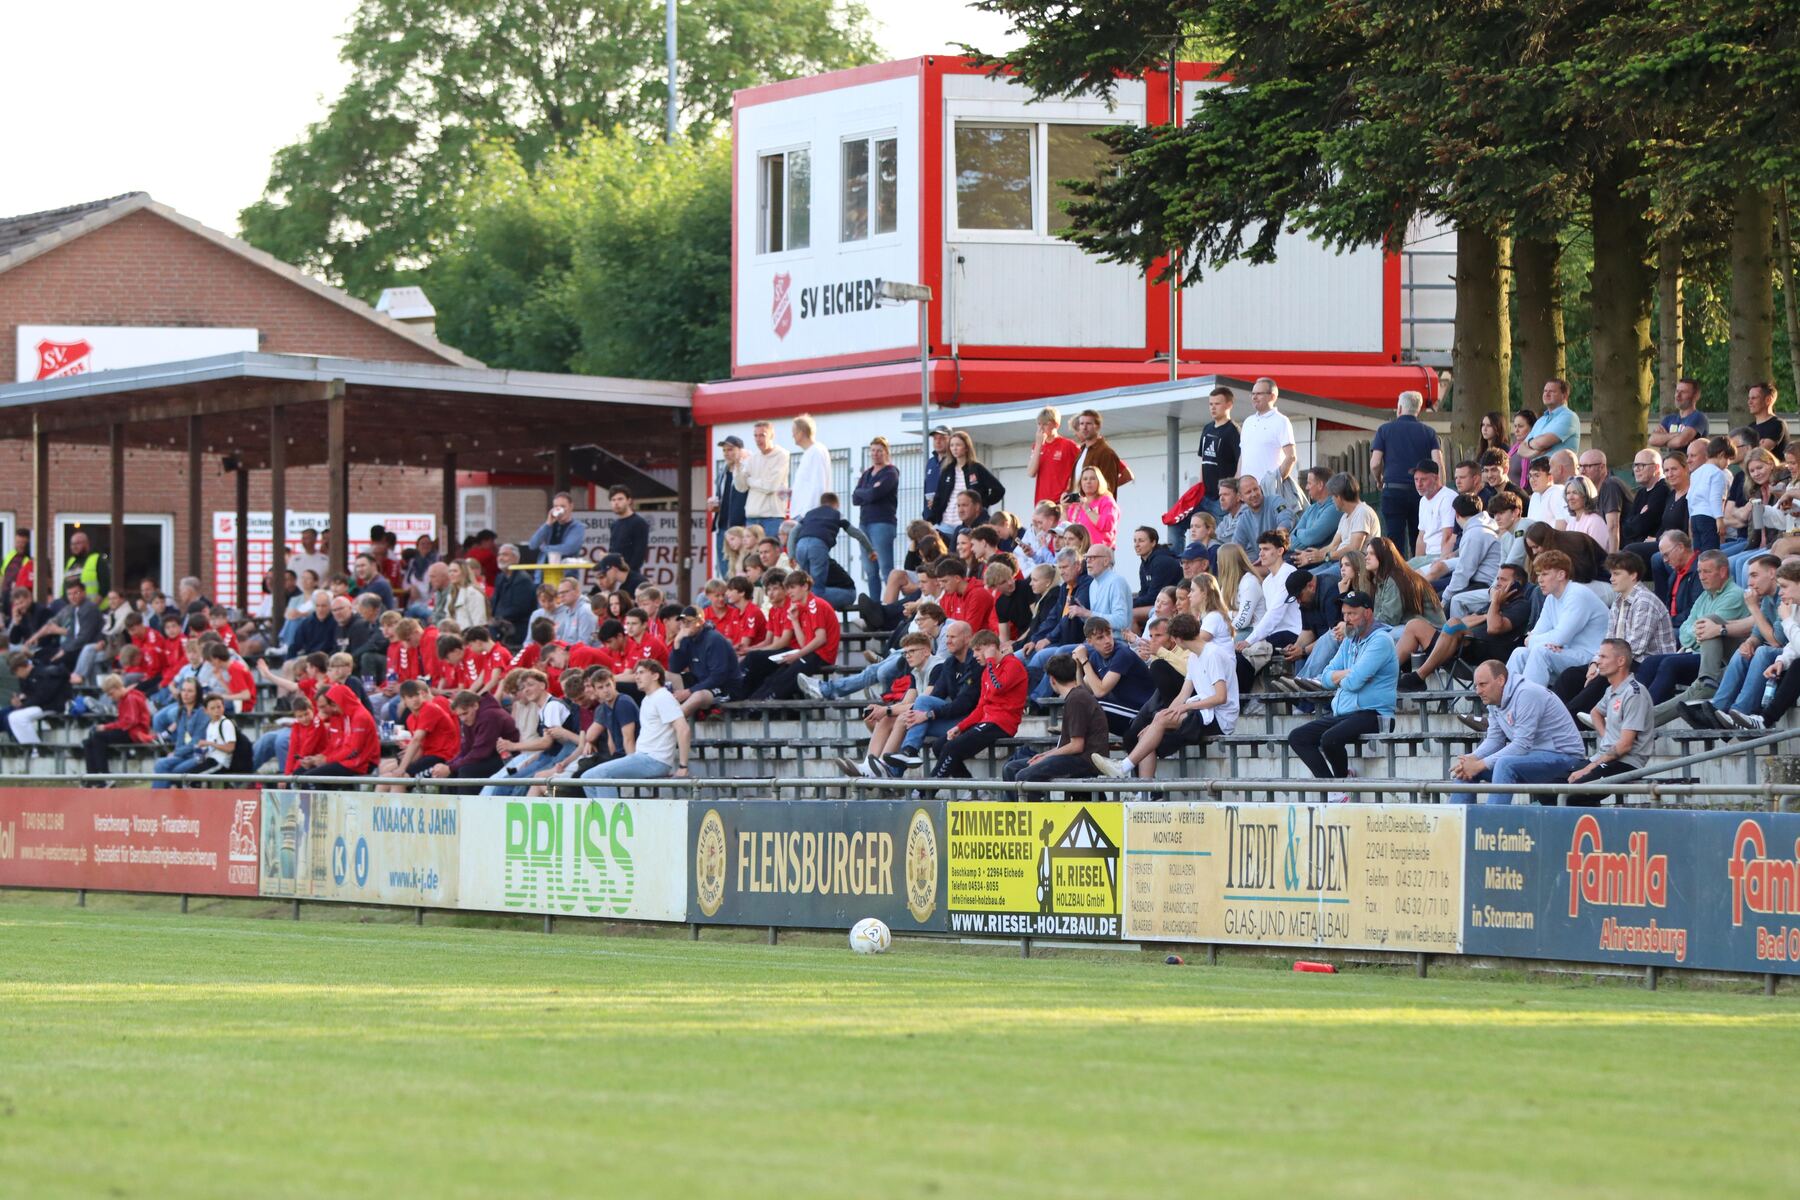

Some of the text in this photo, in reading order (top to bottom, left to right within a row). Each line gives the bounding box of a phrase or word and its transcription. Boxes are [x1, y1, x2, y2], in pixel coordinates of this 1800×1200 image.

[800, 287, 818, 319] SV
[372, 806, 456, 836] KNAACK & JAHN
[951, 810, 1032, 836] ZIMMEREI
[1132, 812, 1205, 825] HERSTELLUNG VERTRIEB
[1433, 816, 1439, 833] 7
[0, 821, 15, 859] oll
[1153, 831, 1183, 844] MONTAGE
[1284, 805, 1301, 891] &
[1475, 827, 1536, 852] Ihre famila-
[335, 846, 366, 878] K J
[737, 831, 893, 895] FLENSBURGER
[951, 841, 1033, 860] DACHDECKEREI
[1366, 842, 1388, 859] 22941
[1004, 867, 1024, 878] Eichede
[1056, 865, 1105, 887] H. RIESEL
[1365, 868, 1389, 887] Telefon
[1484, 866, 1523, 891] Märkte
[1566, 814, 1668, 918] famila
[1728, 819, 1800, 926] fami
[389, 867, 438, 893] www.k-j.de
[952, 880, 967, 891] Telefon
[1056, 893, 1105, 908] HOLZBAU GmbH
[1163, 901, 1199, 914] BRANDSCHUTZ
[1366, 895, 1377, 913] Fax
[951, 913, 1117, 936] WWW.RIESEL-HOLZBAU.DE
[1260, 910, 1286, 936] UND
[1289, 911, 1350, 939] METALLBAU
[1472, 904, 1534, 930] in Stormarn
[1599, 917, 1687, 963] Ahrensburg
[1756, 925, 1800, 962] Bad O
